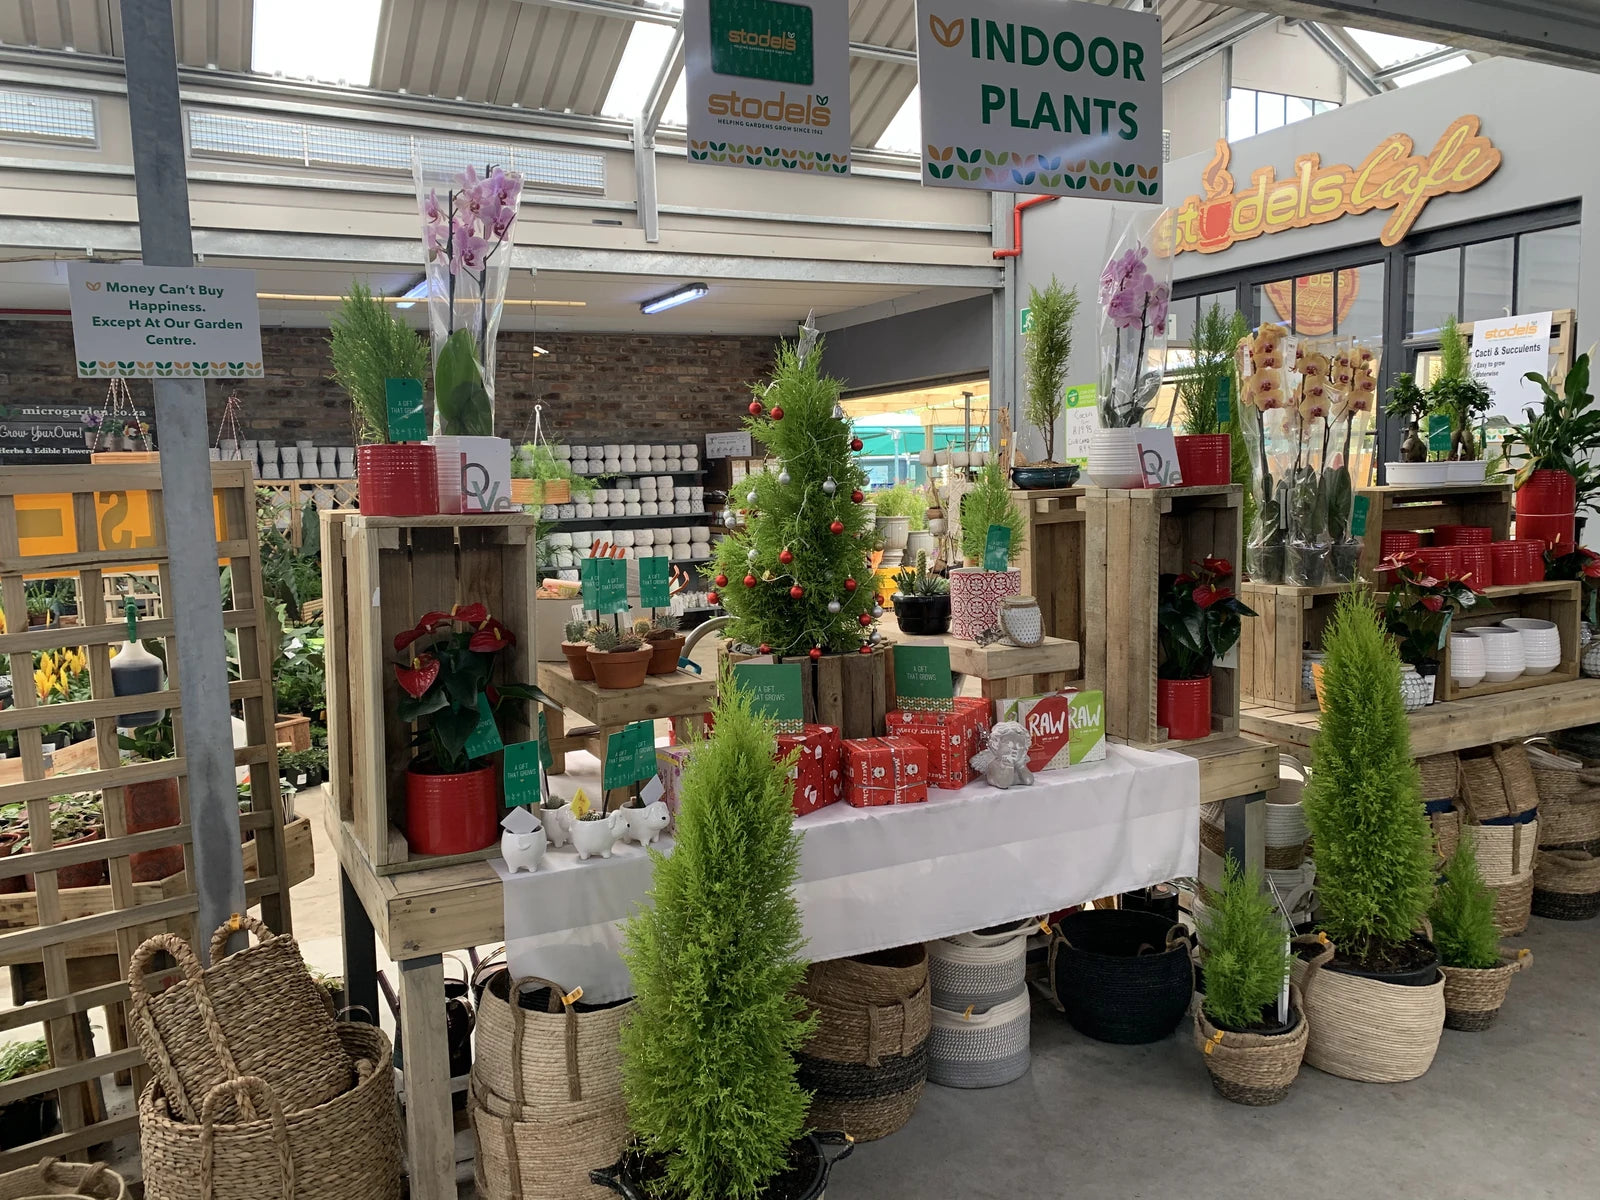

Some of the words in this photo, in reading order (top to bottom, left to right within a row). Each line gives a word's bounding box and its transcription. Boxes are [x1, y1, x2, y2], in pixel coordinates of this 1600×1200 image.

[729, 28, 796, 51] stodels
[971, 17, 1146, 82] INDOOR
[708, 91, 831, 127] stodels
[981, 83, 1139, 141] PLANTS
[717, 118, 744, 127] HELPING
[745, 121, 773, 130] GARDENS
[106, 282, 155, 296] Money
[159, 284, 195, 295] Can't
[199, 285, 224, 298] Buy
[129, 300, 206, 313] Happiness.
[92, 316, 141, 330] Except
[145, 317, 160, 328] At
[164, 318, 189, 329] Our
[194, 319, 243, 329] Garden
[1484, 322, 1538, 339] stodels
[146, 335, 196, 345] Centre.
[1475, 348, 1492, 358] Cacti
[1494, 347, 1499, 356] &
[1501, 344, 1541, 355] Succulents
[22, 406, 146, 418] microgarden.co.za
[0, 425, 28, 438] Grow
[1029, 711, 1067, 737] RAW
[1068, 704, 1101, 729] RAW
[520, 769, 536, 777] GROWS
